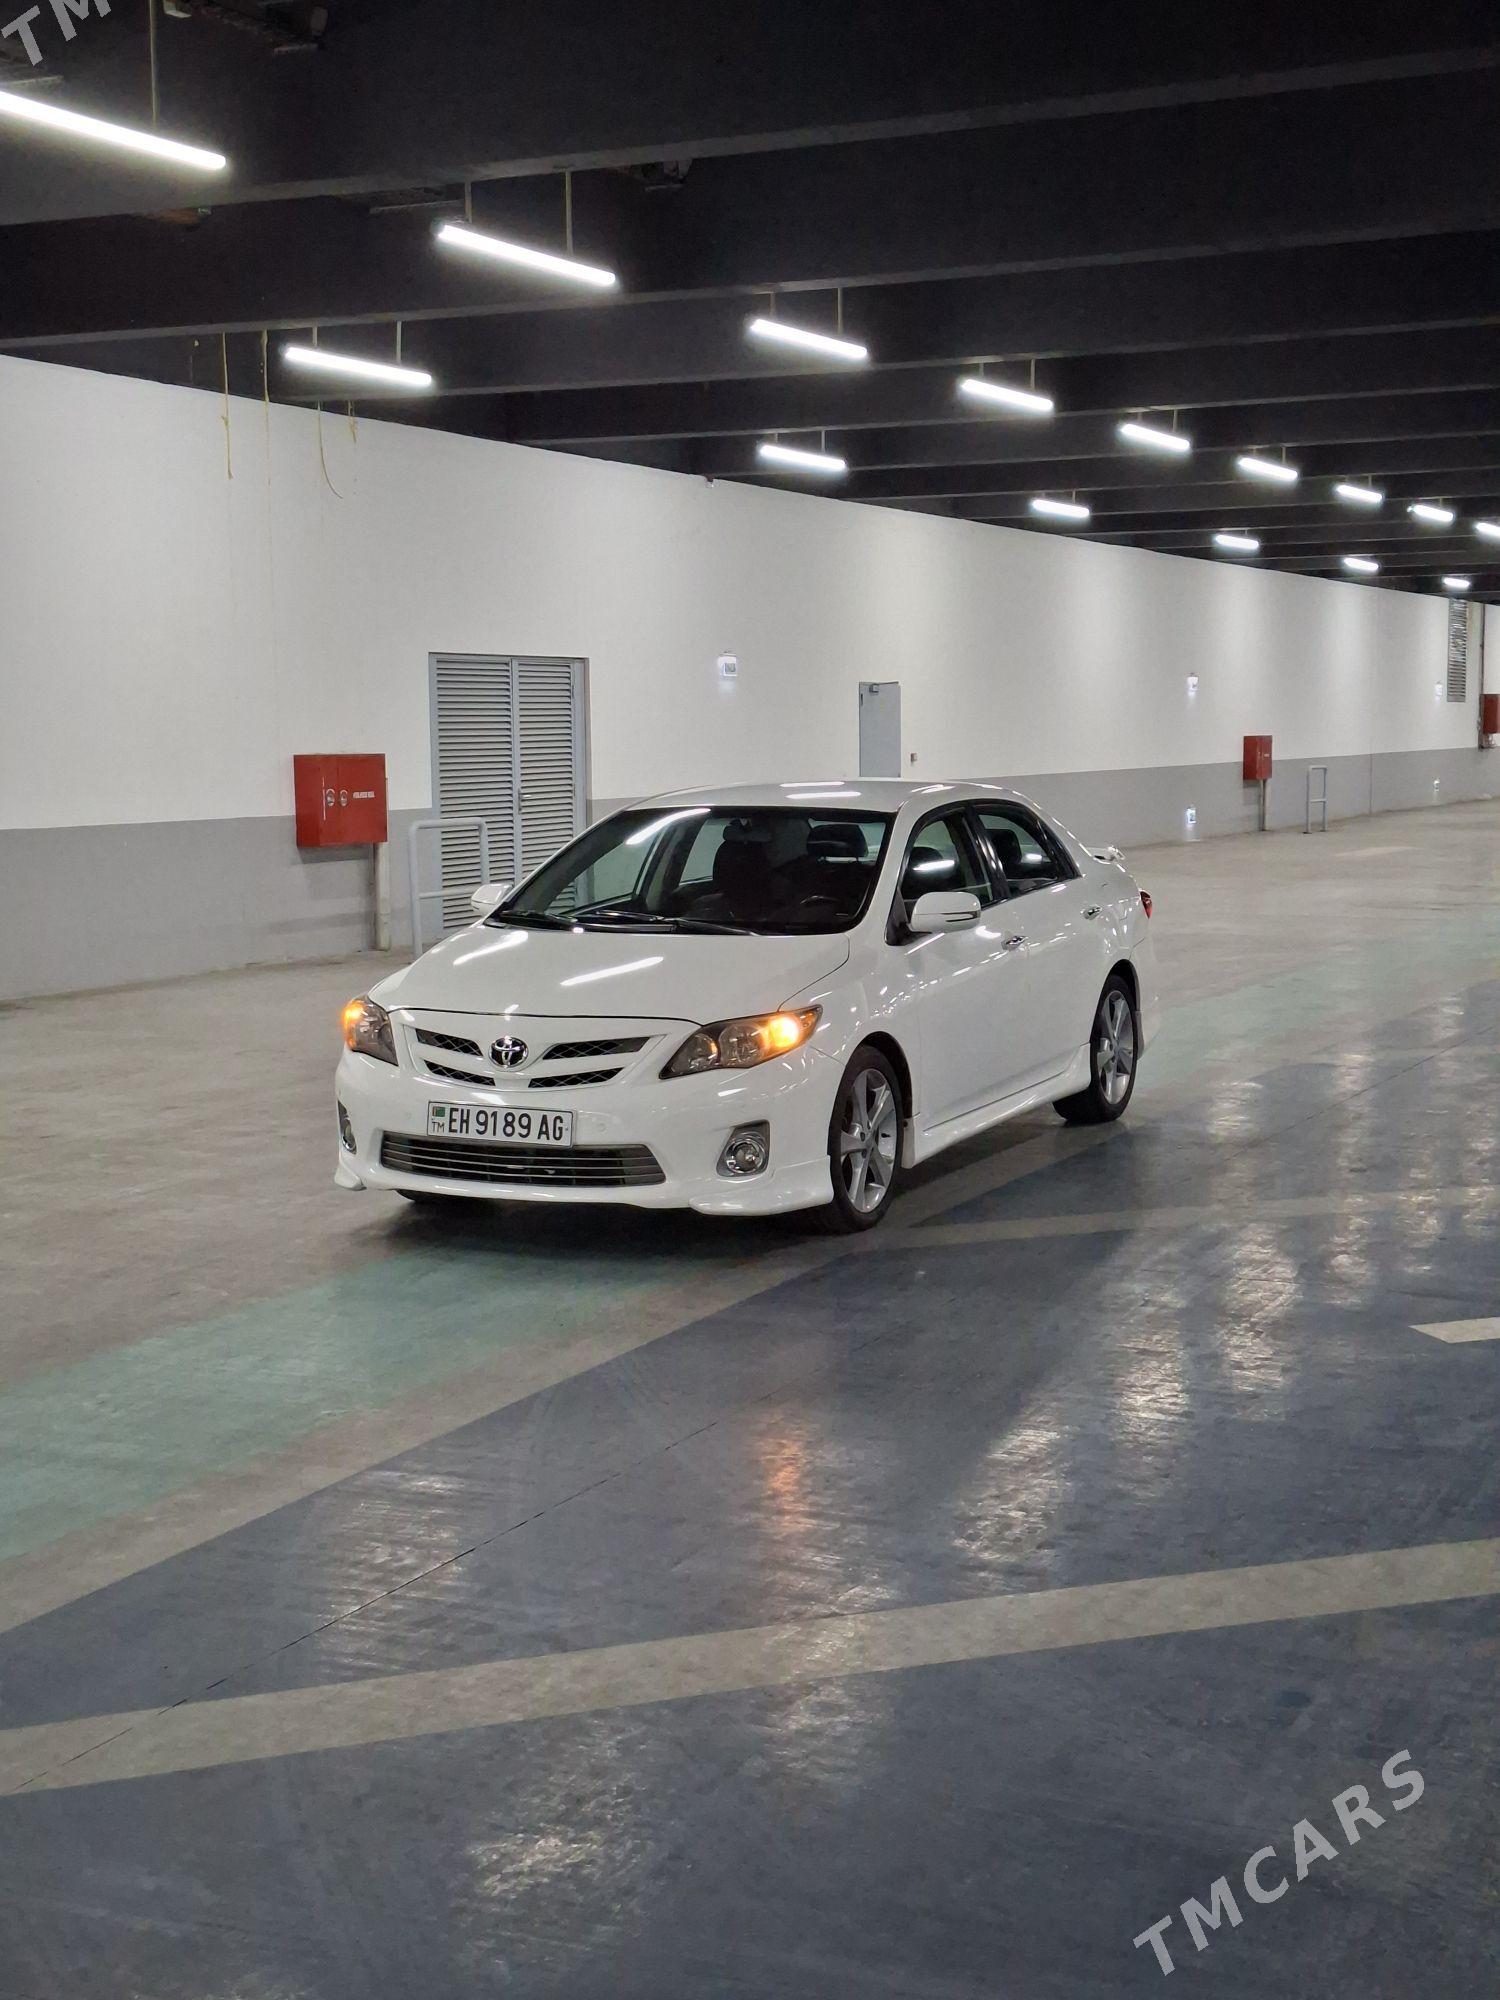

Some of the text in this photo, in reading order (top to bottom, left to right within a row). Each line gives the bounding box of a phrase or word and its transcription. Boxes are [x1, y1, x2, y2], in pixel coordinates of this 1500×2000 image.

[431, 1121, 445, 1134] TM
[449, 1107, 564, 1141] EH 9189 AG
